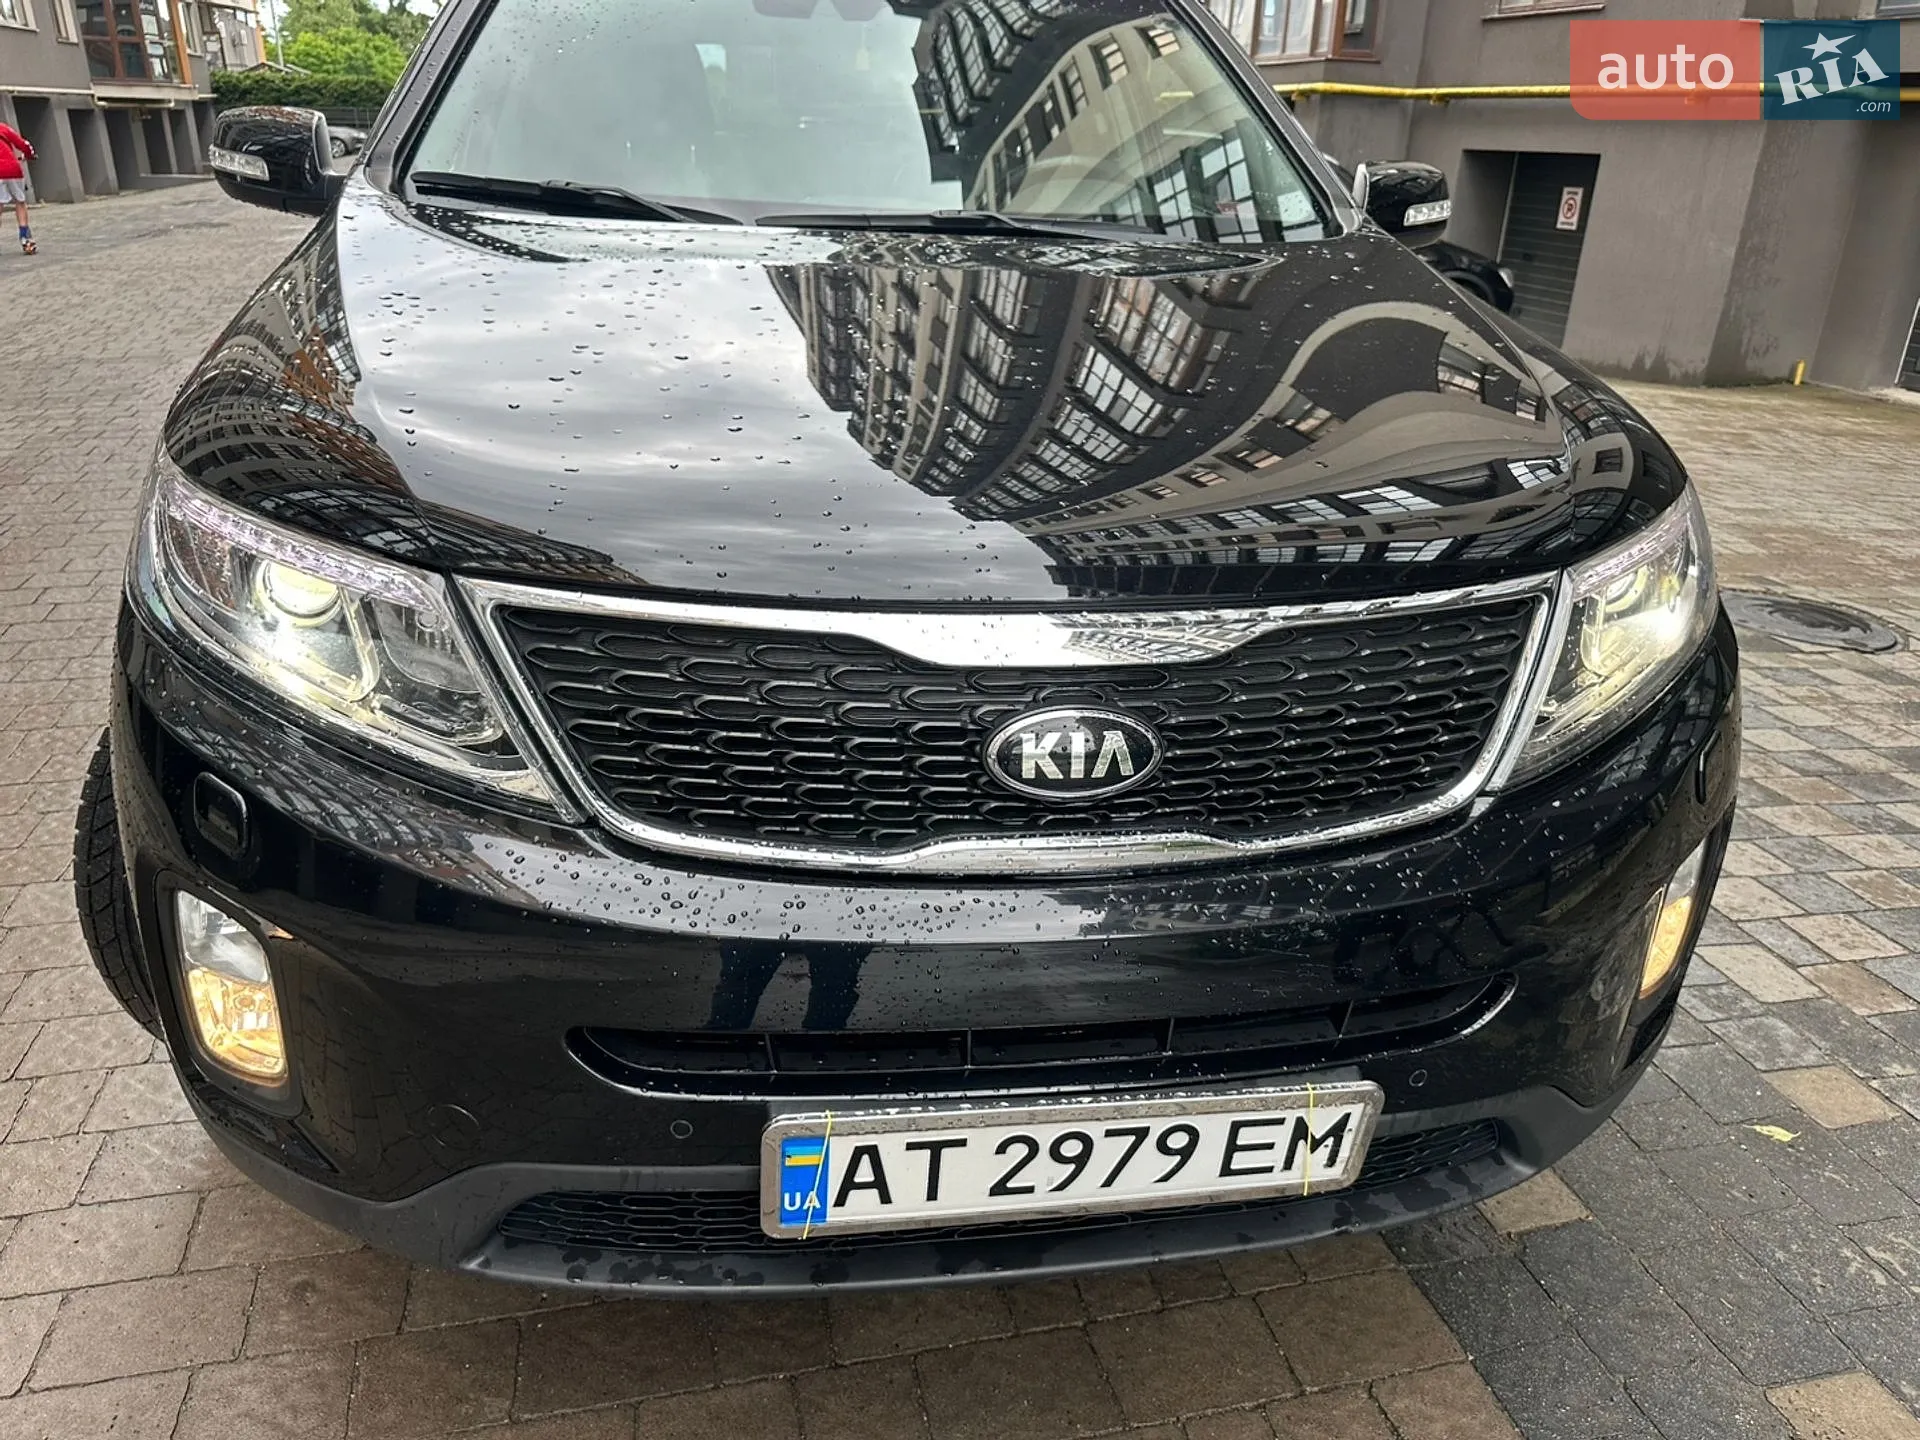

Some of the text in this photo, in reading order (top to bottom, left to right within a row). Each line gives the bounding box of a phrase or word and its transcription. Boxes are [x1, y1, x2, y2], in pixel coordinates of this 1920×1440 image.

[1019, 730, 1135, 779] KIA
[832, 1111, 1353, 1208] AT 2979 EM
[783, 1191, 822, 1211] UA
